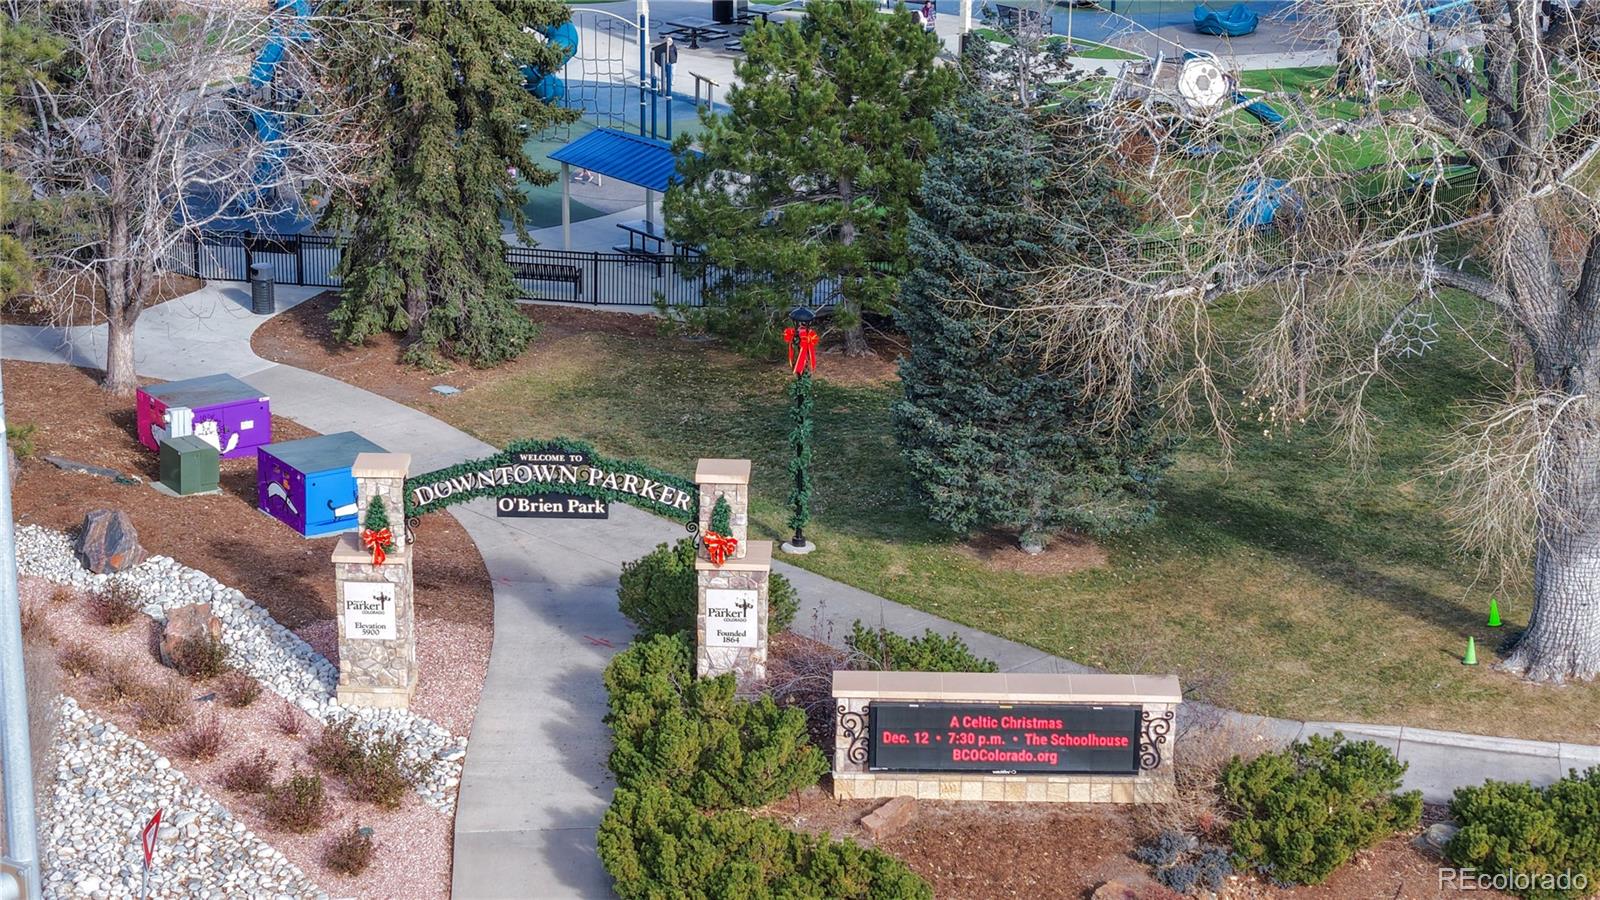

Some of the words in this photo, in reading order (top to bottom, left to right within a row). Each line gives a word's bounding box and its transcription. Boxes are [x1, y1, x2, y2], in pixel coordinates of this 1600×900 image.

[520, 454, 566, 462] WELCOME
[569, 454, 583, 462] TO
[413, 464, 579, 506] DOWNTOWN
[588, 467, 691, 512] PARKER
[498, 497, 563, 512] O'Brien
[567, 499, 606, 514] Park
[346, 600, 380, 610] Parker
[708, 608, 742, 618] Parker
[355, 622, 387, 630] Elevation
[950, 716, 960, 728] A
[962, 716, 998, 729] Celtic
[1001, 716, 1063, 729] Christmas
[882, 731, 910, 744] Dec.
[914, 732, 930, 744] 12
[948, 732, 976, 745] 7:30
[978, 735, 1006, 747] p.m.
[1024, 733, 1048, 746] The
[1050, 733, 1129, 747] Schoolhouse
[952, 749, 1058, 765] BCOColorado.org
